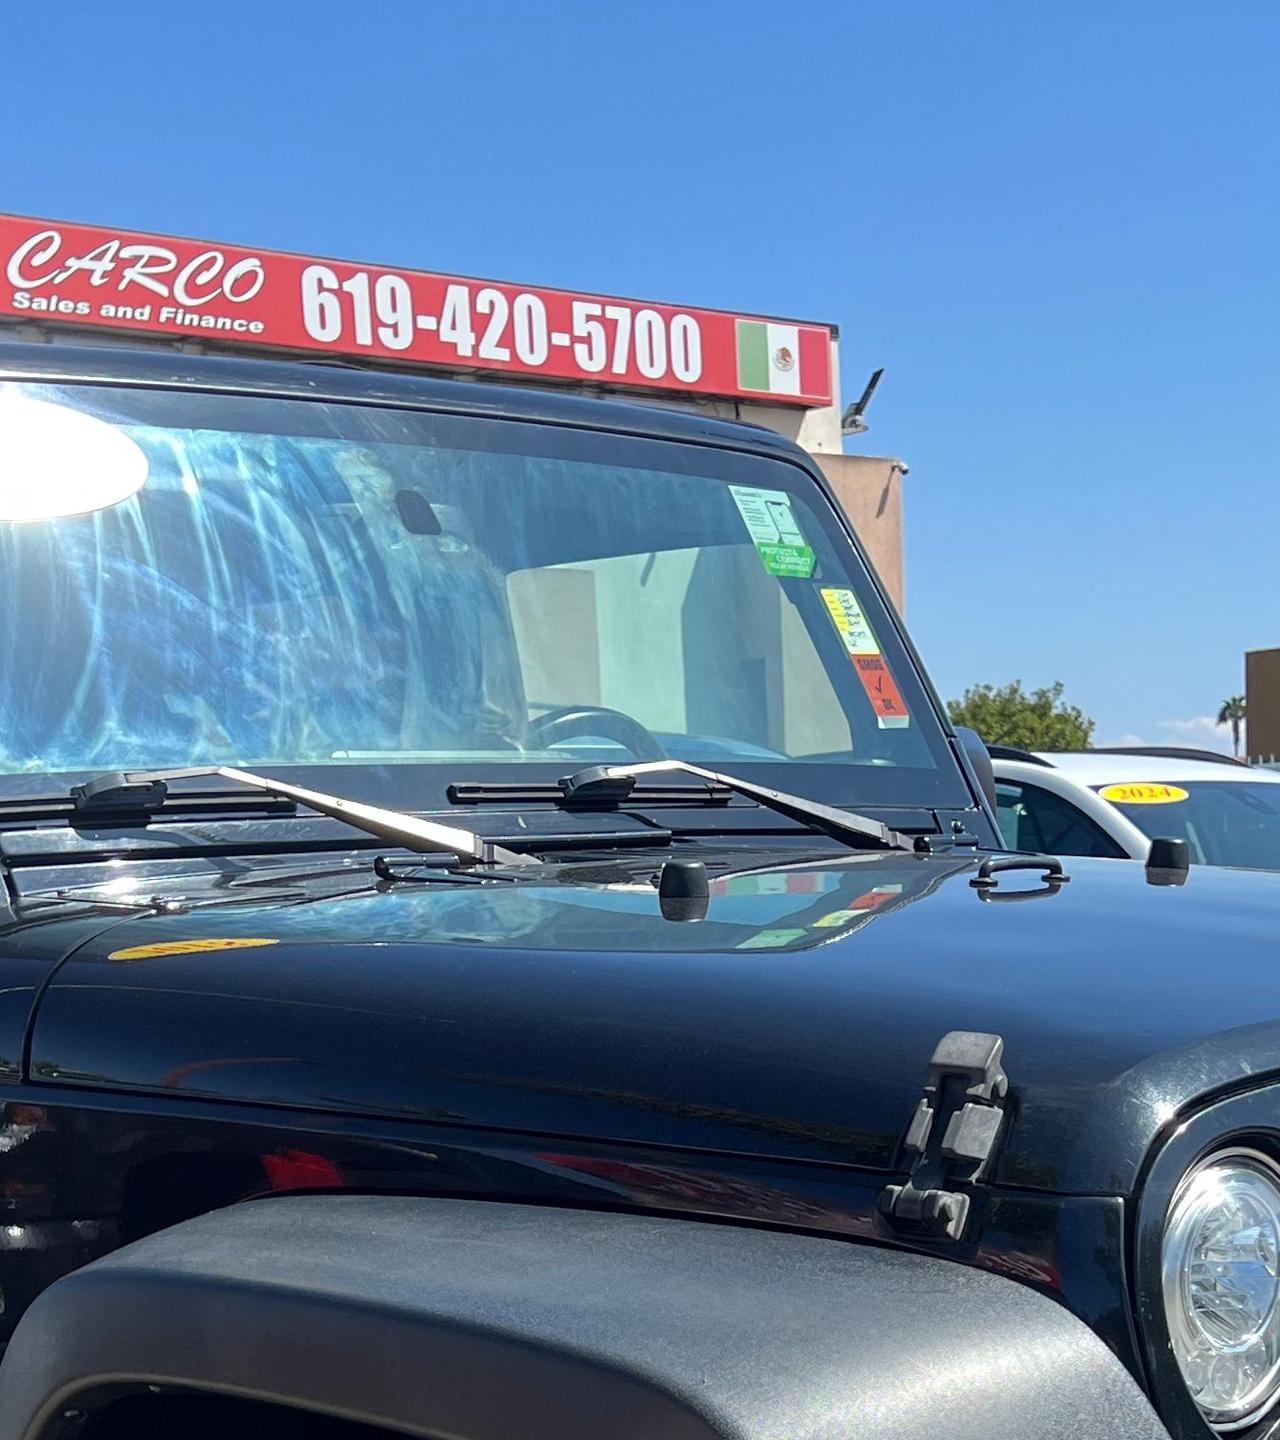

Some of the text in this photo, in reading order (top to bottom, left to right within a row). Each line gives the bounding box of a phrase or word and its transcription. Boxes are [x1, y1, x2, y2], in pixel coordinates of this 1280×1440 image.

[6, 230, 266, 307] CARCO
[11, 290, 266, 334] Sales and Finance
[300, 264, 703, 384] 619-420-5700
